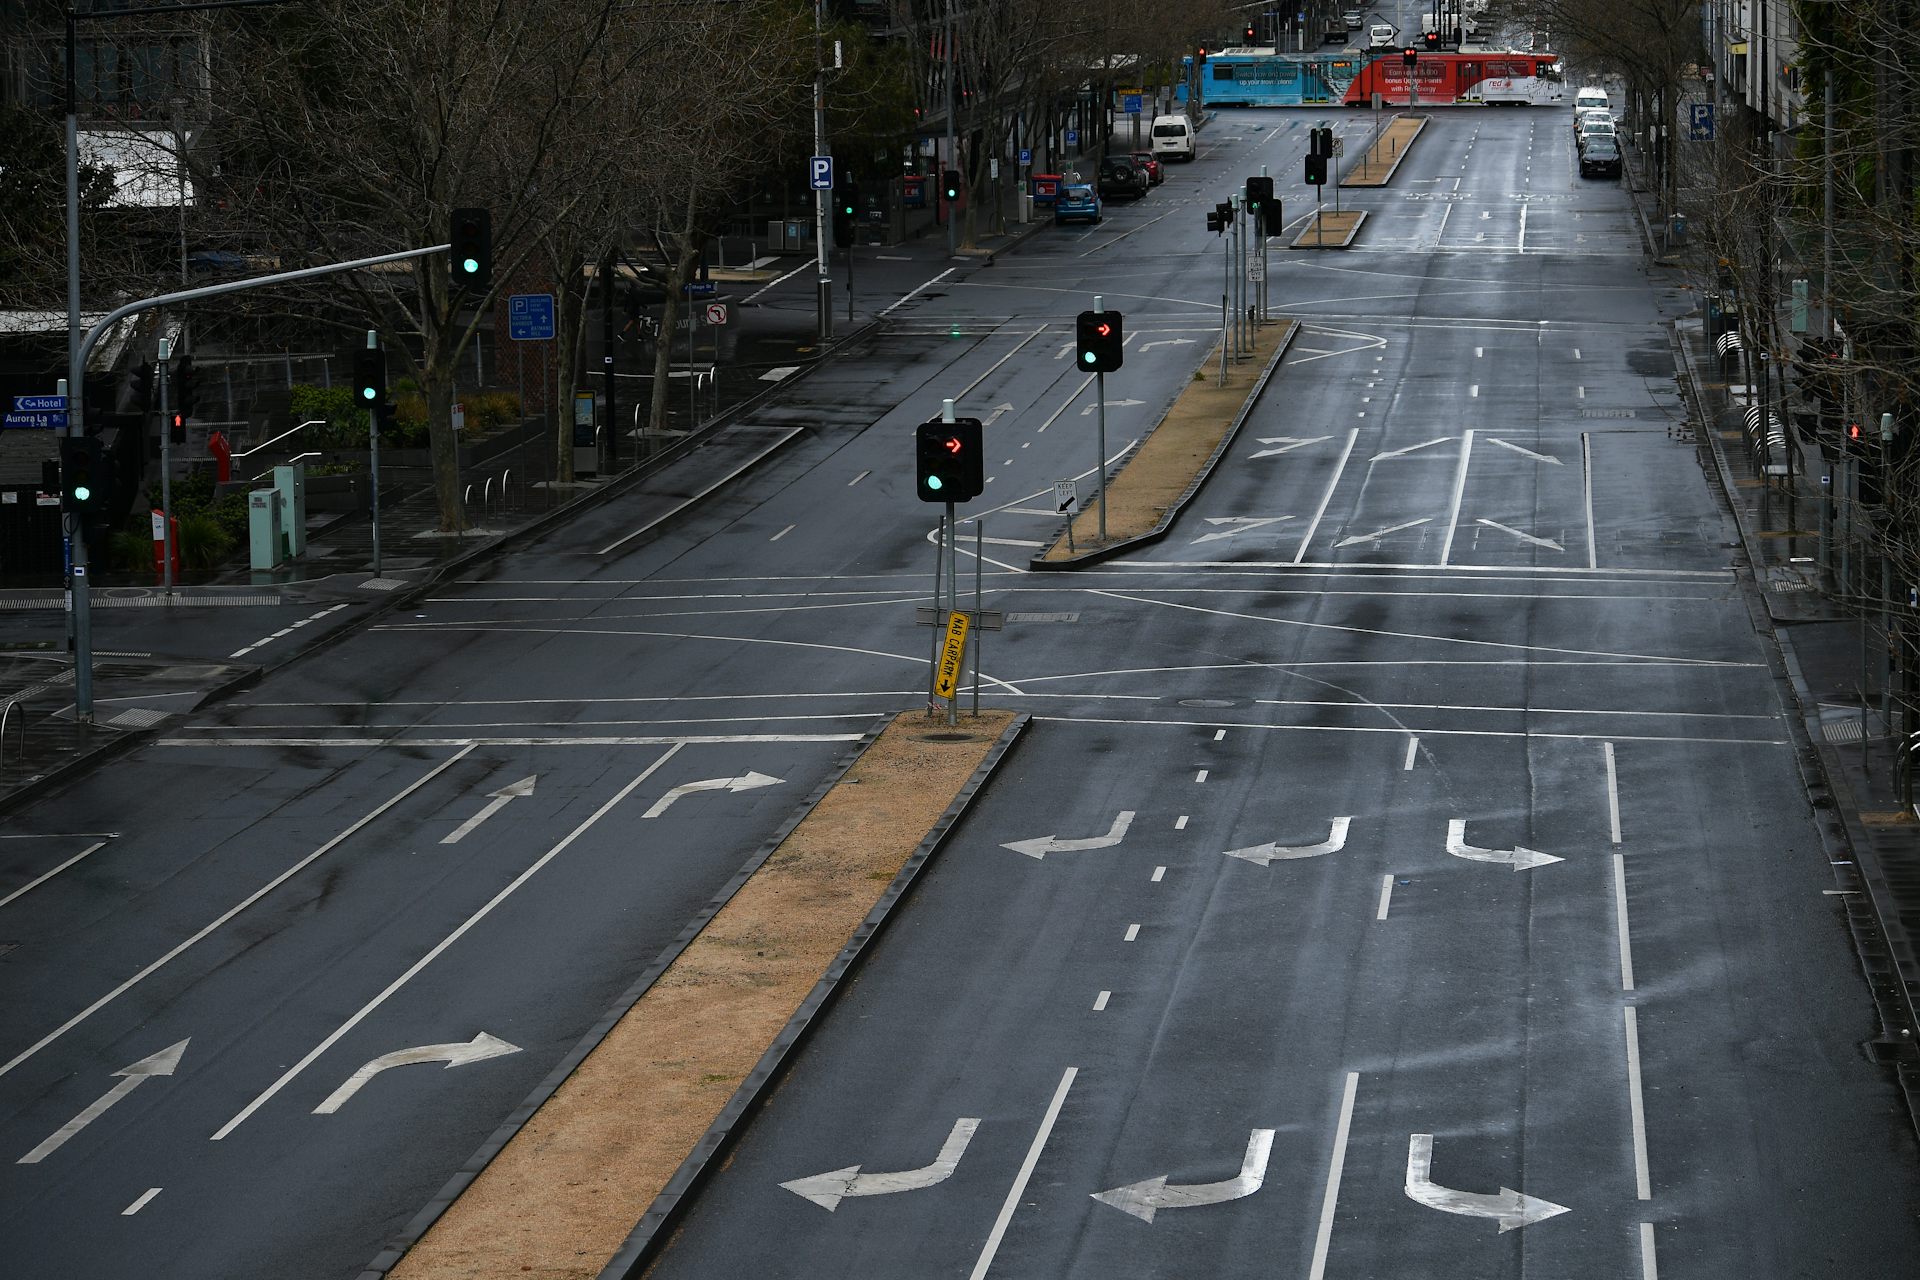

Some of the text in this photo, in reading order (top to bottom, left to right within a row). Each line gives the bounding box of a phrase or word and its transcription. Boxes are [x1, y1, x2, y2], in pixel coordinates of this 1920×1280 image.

[1021, 151, 1028, 160] P
[814, 160, 829, 180] P
[515, 300, 524, 311] P
[37, 399, 62, 408] Hotel
[5, 413, 48, 423] Aurora La
[943, 617, 964, 677] NAB CARPARK
